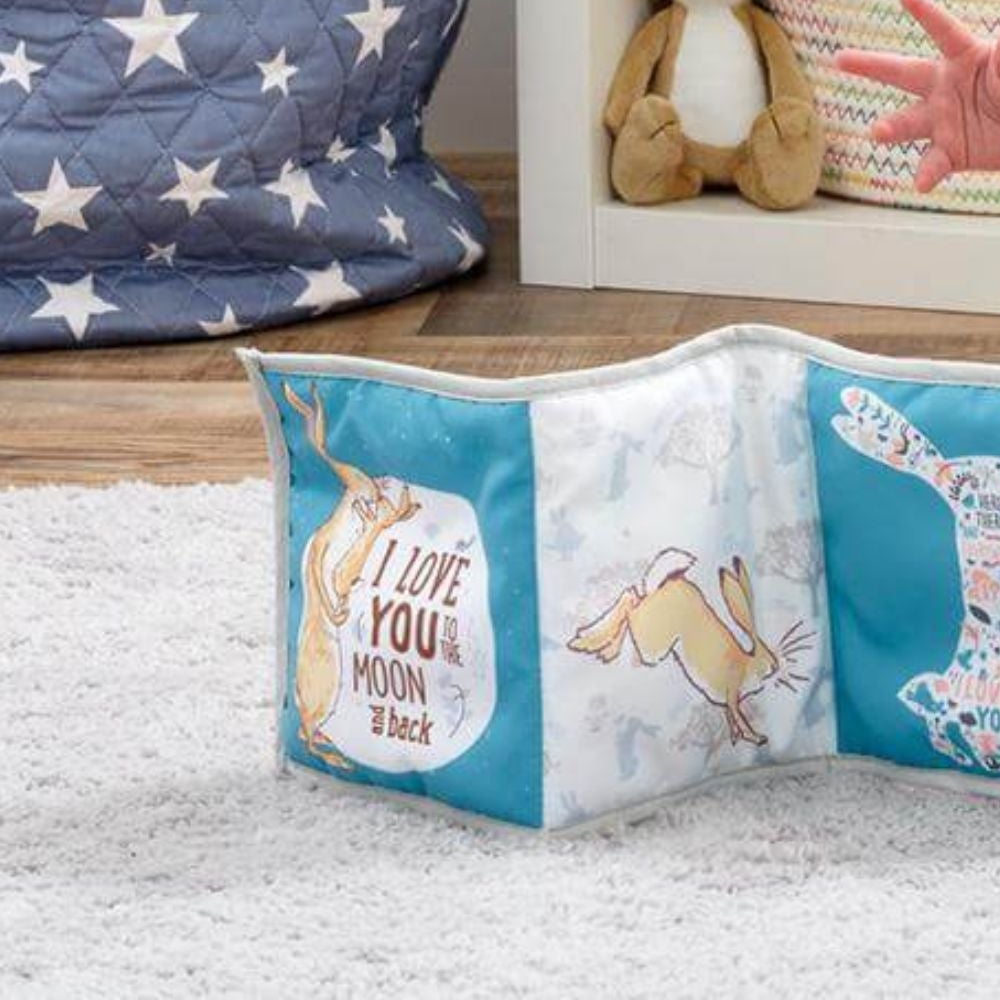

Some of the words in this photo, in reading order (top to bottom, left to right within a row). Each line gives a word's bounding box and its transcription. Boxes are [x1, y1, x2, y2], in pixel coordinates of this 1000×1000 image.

[372, 539, 398, 588] I
[395, 545, 471, 607] LOVE
[371, 595, 439, 660] YOU
[352, 651, 427, 706] MOON
[387, 705, 434, 745] back
